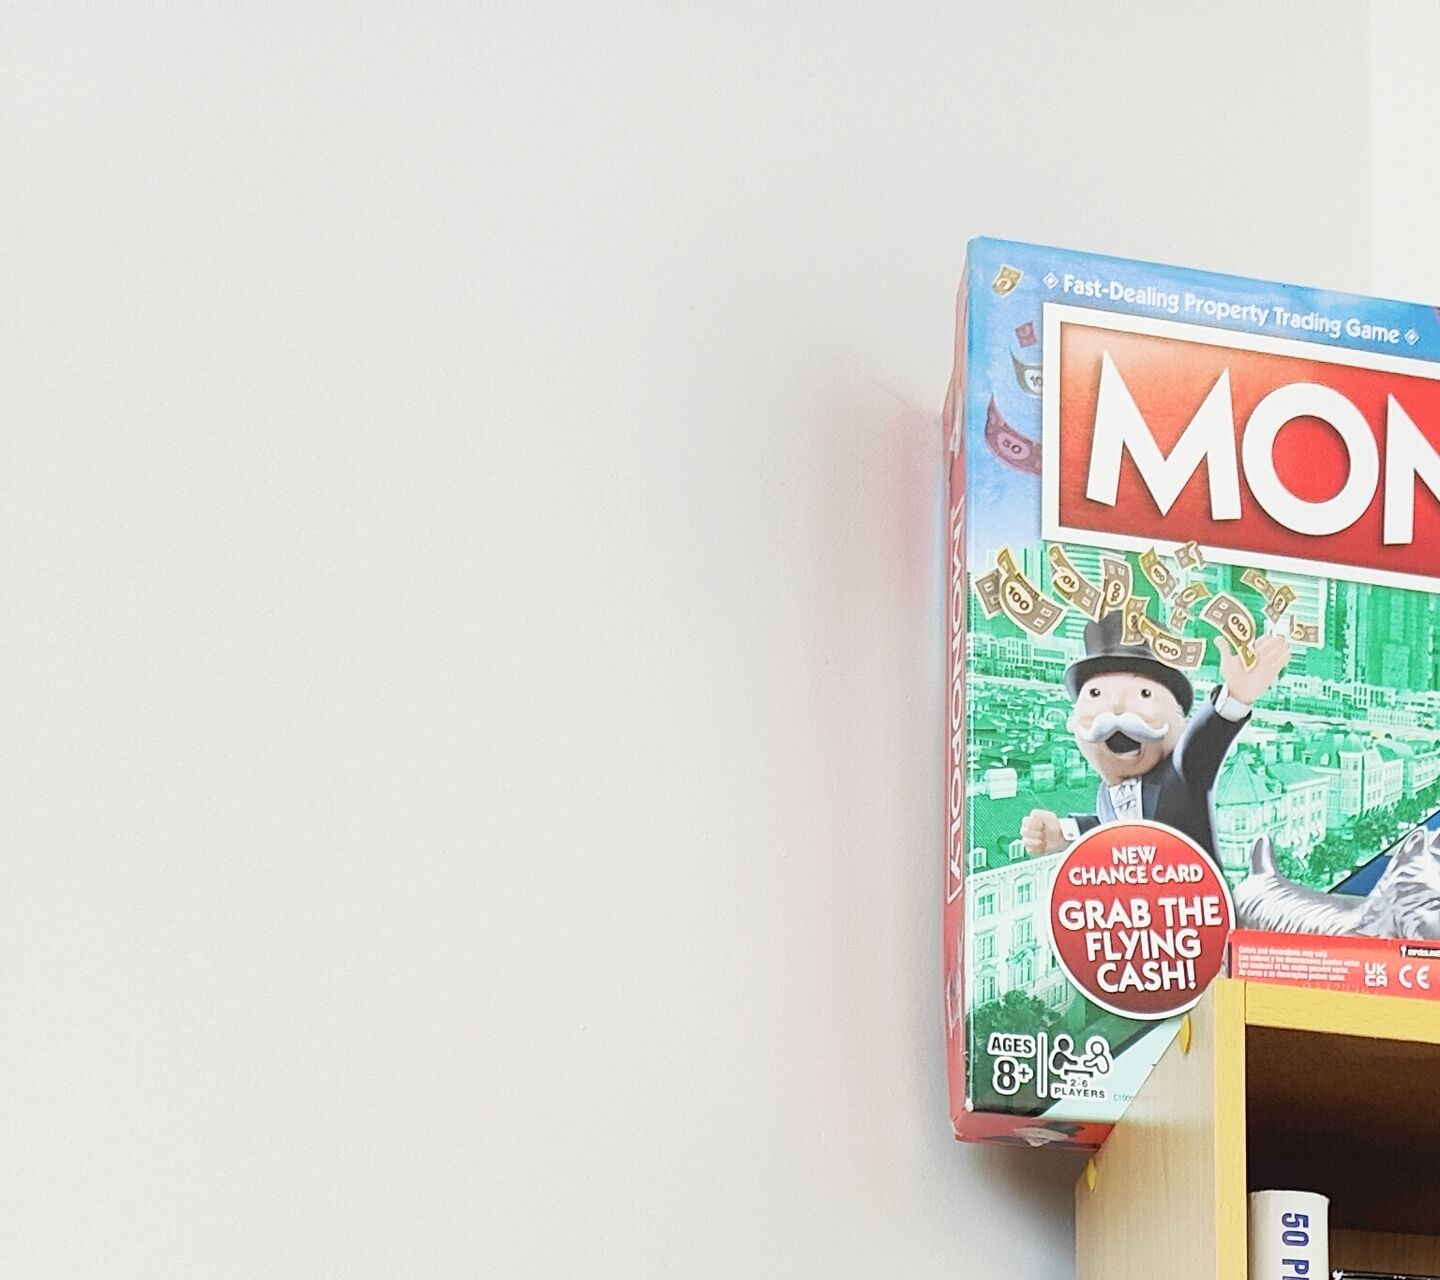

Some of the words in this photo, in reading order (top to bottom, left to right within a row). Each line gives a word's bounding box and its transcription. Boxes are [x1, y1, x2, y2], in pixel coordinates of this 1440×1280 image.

[1064, 274, 1178, 313] Fast-Dealing
[1185, 293, 1268, 327] Property
[1273, 306, 1342, 338] Trading
[1346, 316, 1400, 344] Game
[1007, 585, 1030, 612] 100
[1158, 641, 1179, 658] 100
[1111, 846, 1157, 866] NEW
[1068, 864, 1149, 886] CHANCE
[1150, 864, 1203, 884] CARD
[1058, 899, 1153, 932] GRAB
[1157, 897, 1223, 928] THE
[1086, 930, 1201, 962] FLYING
[1097, 961, 1197, 995] CASH!
[1364, 962, 1387, 975] UK
[1364, 975, 1388, 987] CA
[991, 1036, 1032, 1054] AGES
[996, 1059, 1029, 1091] 8+
[1054, 1087, 1106, 1099] PLAYERS
[1282, 1213, 1309, 1247] 50
